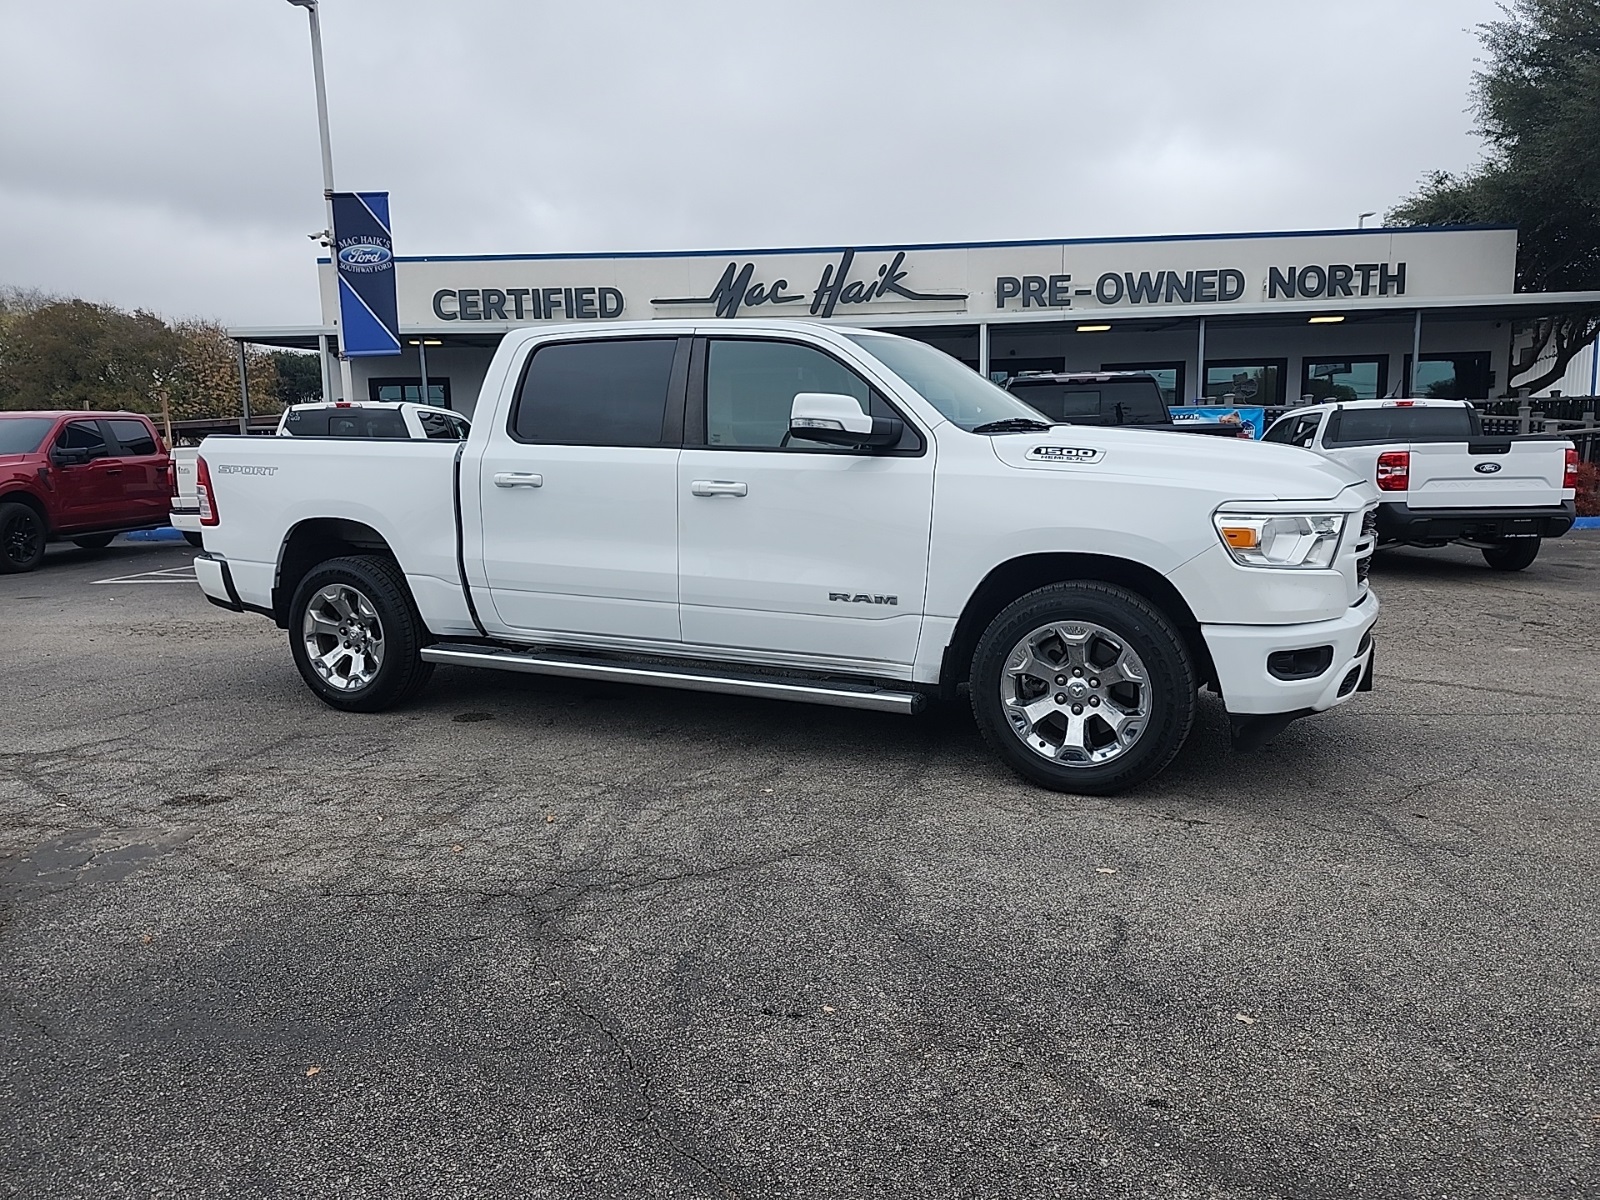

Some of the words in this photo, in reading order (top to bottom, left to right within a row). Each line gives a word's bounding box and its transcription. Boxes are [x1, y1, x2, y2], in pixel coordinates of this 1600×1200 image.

[338, 236, 358, 248] MAC
[360, 235, 391, 249] HAIK'S
[348, 248, 381, 263] Ford
[339, 262, 373, 273] SOUTHWAY
[373, 261, 392, 272] FORD
[650, 262, 804, 318] Mac
[809, 248, 968, 318] Haik
[996, 268, 1246, 308] PRE-OWNED
[1267, 262, 1408, 299] NORTH
[432, 287, 625, 321] CERTIFIED
[1039, 447, 1095, 457] 1500
[218, 464, 279, 476] SPORT
[828, 591, 899, 606] RAM
